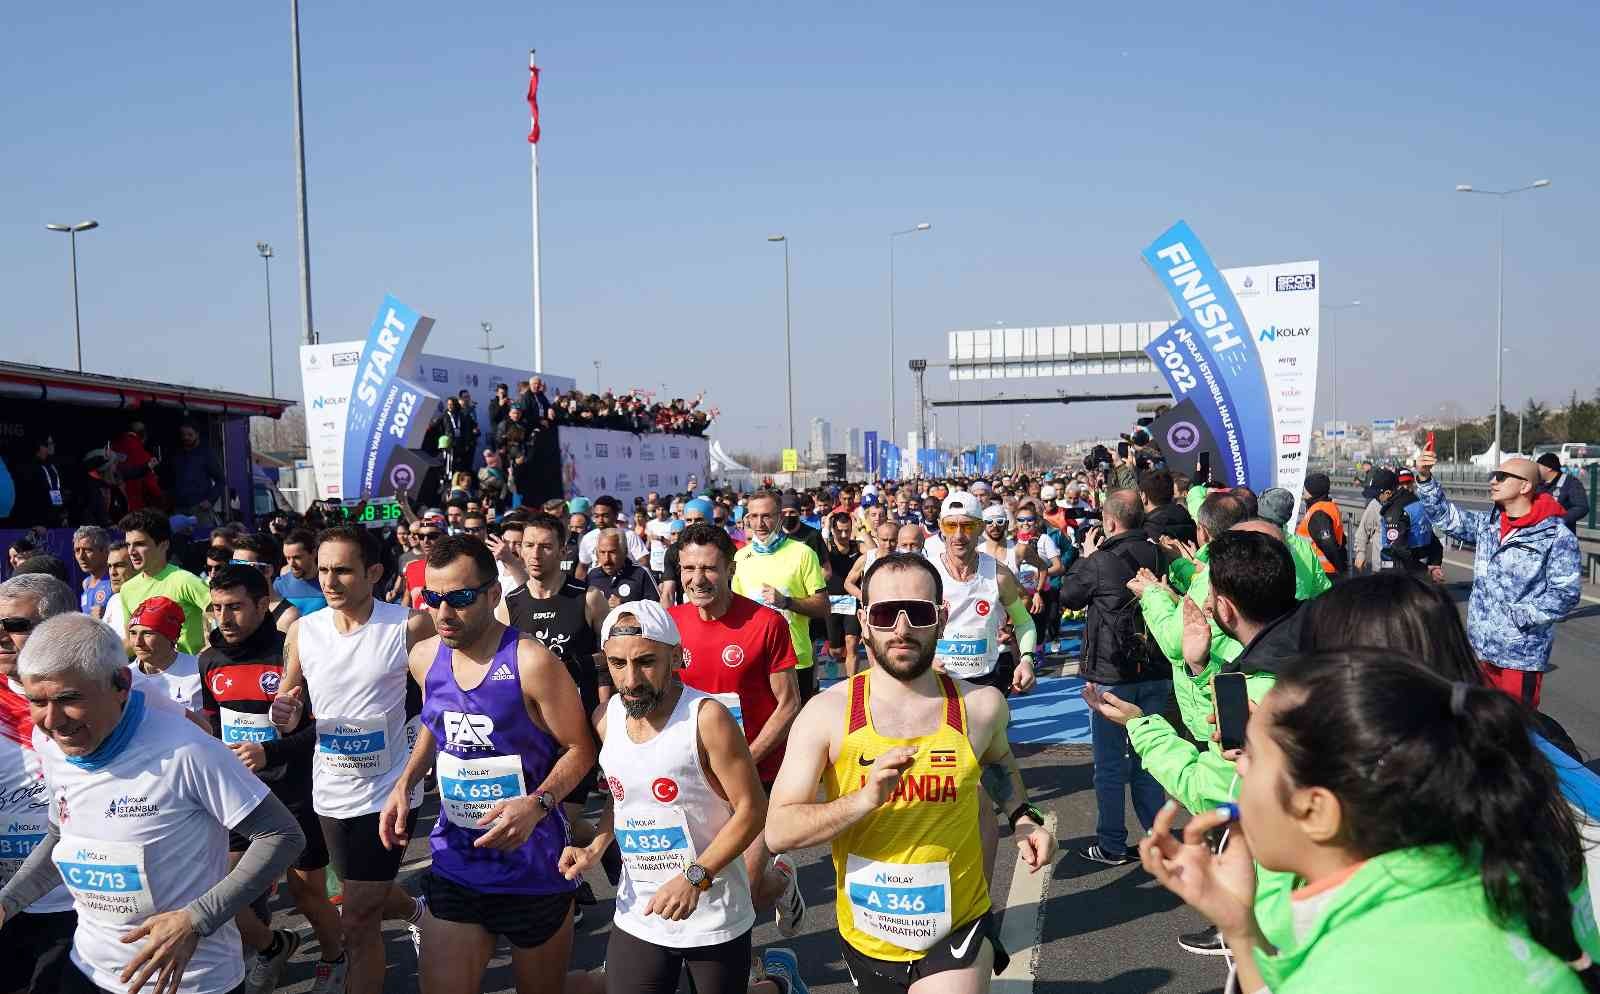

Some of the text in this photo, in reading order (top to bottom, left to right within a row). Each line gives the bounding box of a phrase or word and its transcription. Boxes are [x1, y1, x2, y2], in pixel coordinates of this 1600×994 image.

[1157, 241, 1242, 352] FINISH
[357, 308, 406, 407] START
[1156, 340, 1197, 393] 2022
[389, 391, 417, 439] 2022
[1218, 404, 1233, 429] HALF
[1226, 430, 1246, 486] MARATHON
[948, 643, 977, 654] A 711
[230, 729, 239, 740] C
[443, 711, 495, 746] FAR
[331, 739, 370, 752] A 497
[454, 784, 503, 798] A 638
[861, 774, 957, 802] ANDA
[1, 840, 12, 854] B
[624, 833, 671, 849] A 836
[637, 863, 681, 871] MARATHON
[69, 867, 127, 889] C 2713
[887, 875, 914, 884] KOLAY
[868, 891, 926, 911] A 346
[880, 922, 931, 937] MARATHON
[911, 919, 931, 927] HALF
